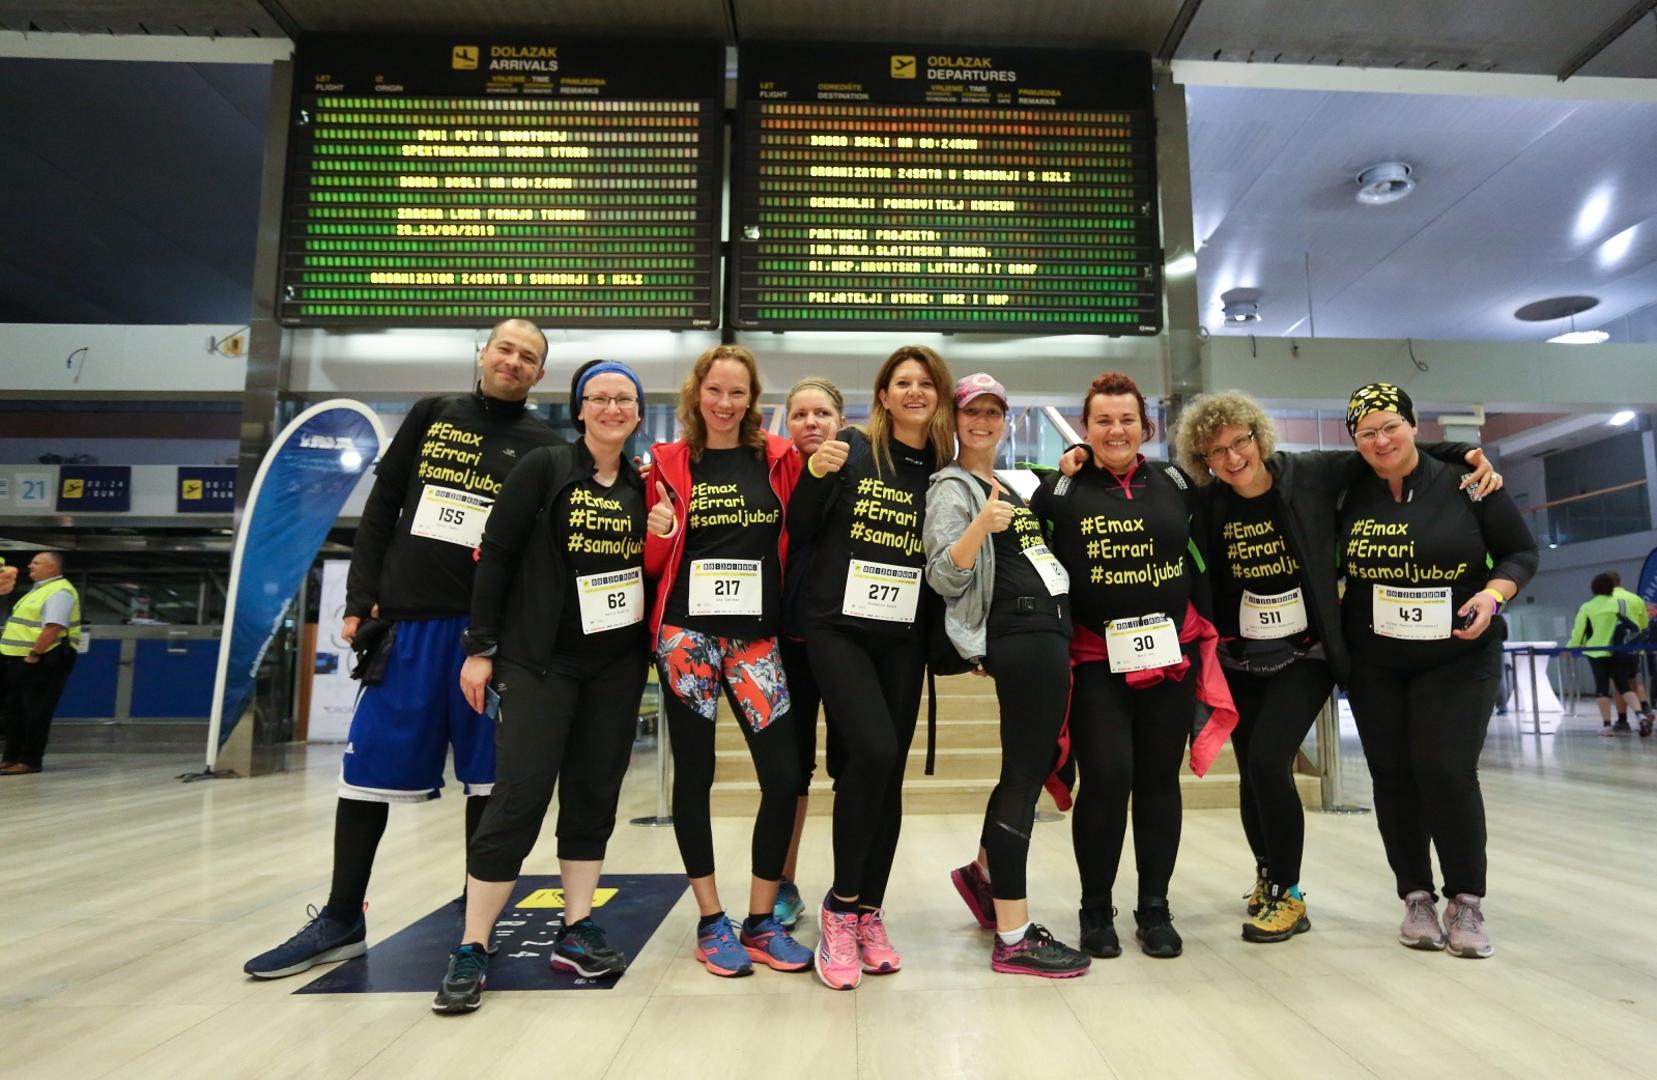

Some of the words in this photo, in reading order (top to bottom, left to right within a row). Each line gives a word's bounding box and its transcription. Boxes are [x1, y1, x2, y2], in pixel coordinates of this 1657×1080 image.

[491, 46, 558, 58] DOLAZAK
[489, 59, 559, 72] ARRIVALS
[927, 56, 992, 68] ODLAZAK
[927, 69, 1017, 82] DEPARTURES
[315, 84, 343, 92] FLIGHT
[759, 91, 788, 99] FLIGHT
[817, 92, 869, 100] DESTINATION
[969, 85, 987, 93] TIME
[1018, 97, 1056, 105] REMARKS
[455, 130, 478, 141] PUT
[427, 422, 483, 447] #Emax
[421, 440, 482, 466] #Errari
[22, 480, 45, 500] 21
[691, 482, 738, 499] #Emax
[857, 477, 913, 505] #Emax
[569, 487, 623, 511] #Emax
[689, 495, 745, 513] #Errari
[439, 507, 465, 526] 155
[568, 509, 632, 532] #Errari
[853, 498, 917, 528] #Errari
[1080, 515, 1144, 535] #Emax
[1223, 520, 1275, 540] #Emax
[1350, 519, 1409, 536] #Emax
[850, 521, 926, 556] #samolju
[1228, 535, 1286, 559] #Errari
[1087, 538, 1154, 559] #Errari
[1347, 539, 1415, 558] #Errari
[714, 580, 741, 596] 217
[868, 584, 900, 602] 277
[607, 592, 626, 609] 62
[1259, 611, 1282, 625] 511
[1399, 607, 1423, 622] 43
[1133, 635, 1155, 652] 30
